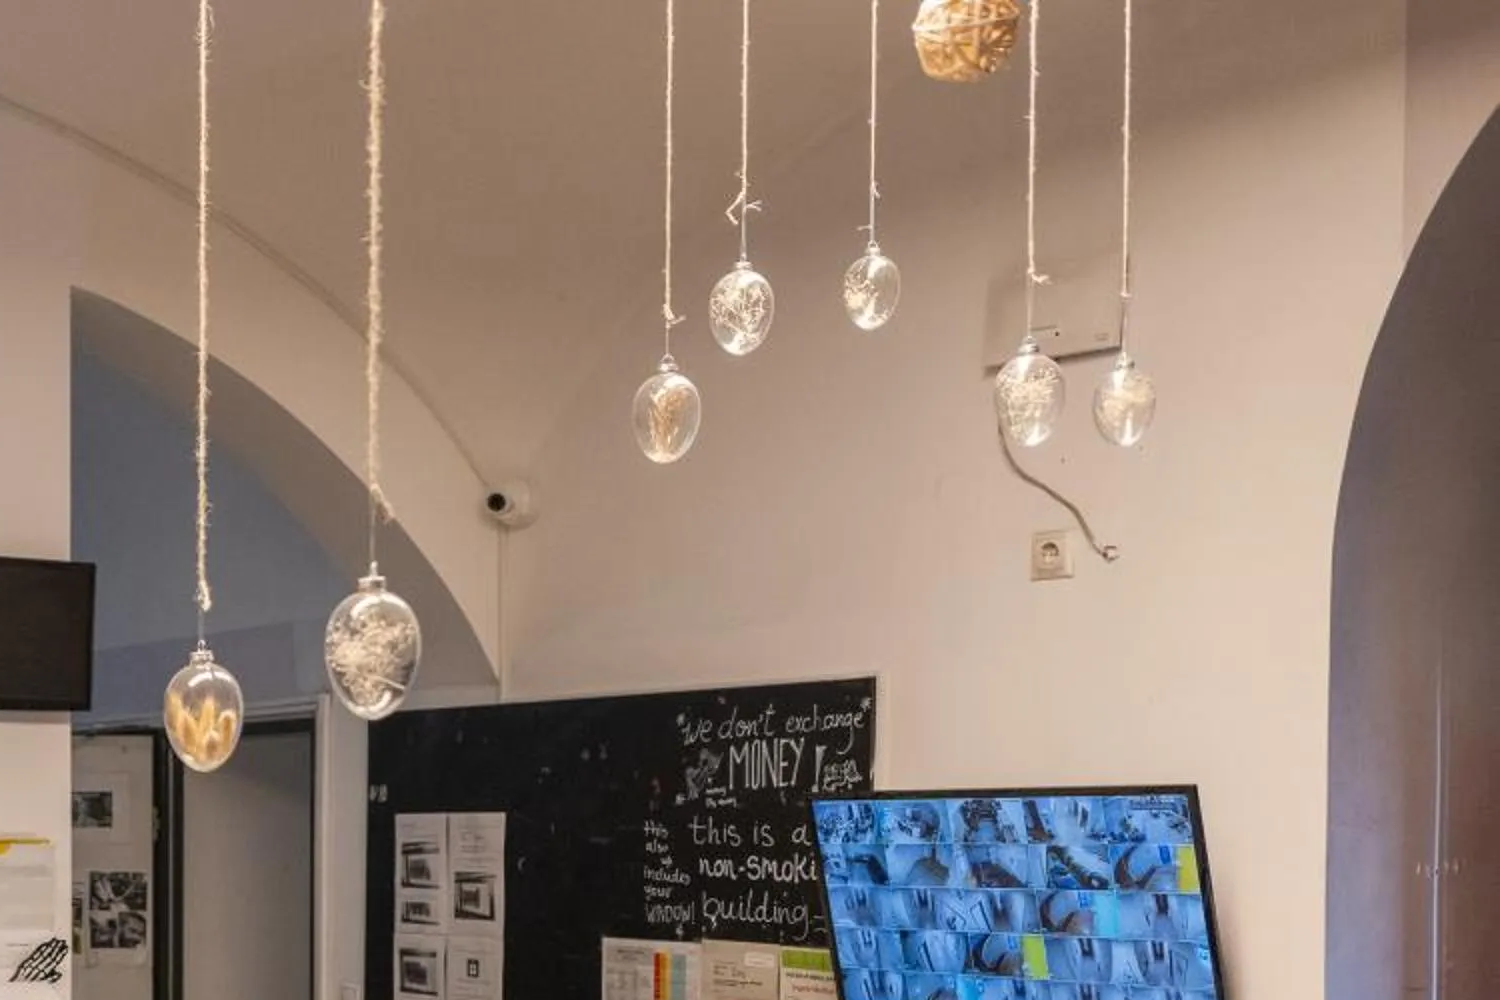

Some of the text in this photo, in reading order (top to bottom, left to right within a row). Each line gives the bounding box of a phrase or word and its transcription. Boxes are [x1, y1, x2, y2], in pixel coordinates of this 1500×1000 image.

[720, 703, 776, 740] don't
[688, 816, 812, 846] this is a
[699, 852, 819, 885] non-smoki
